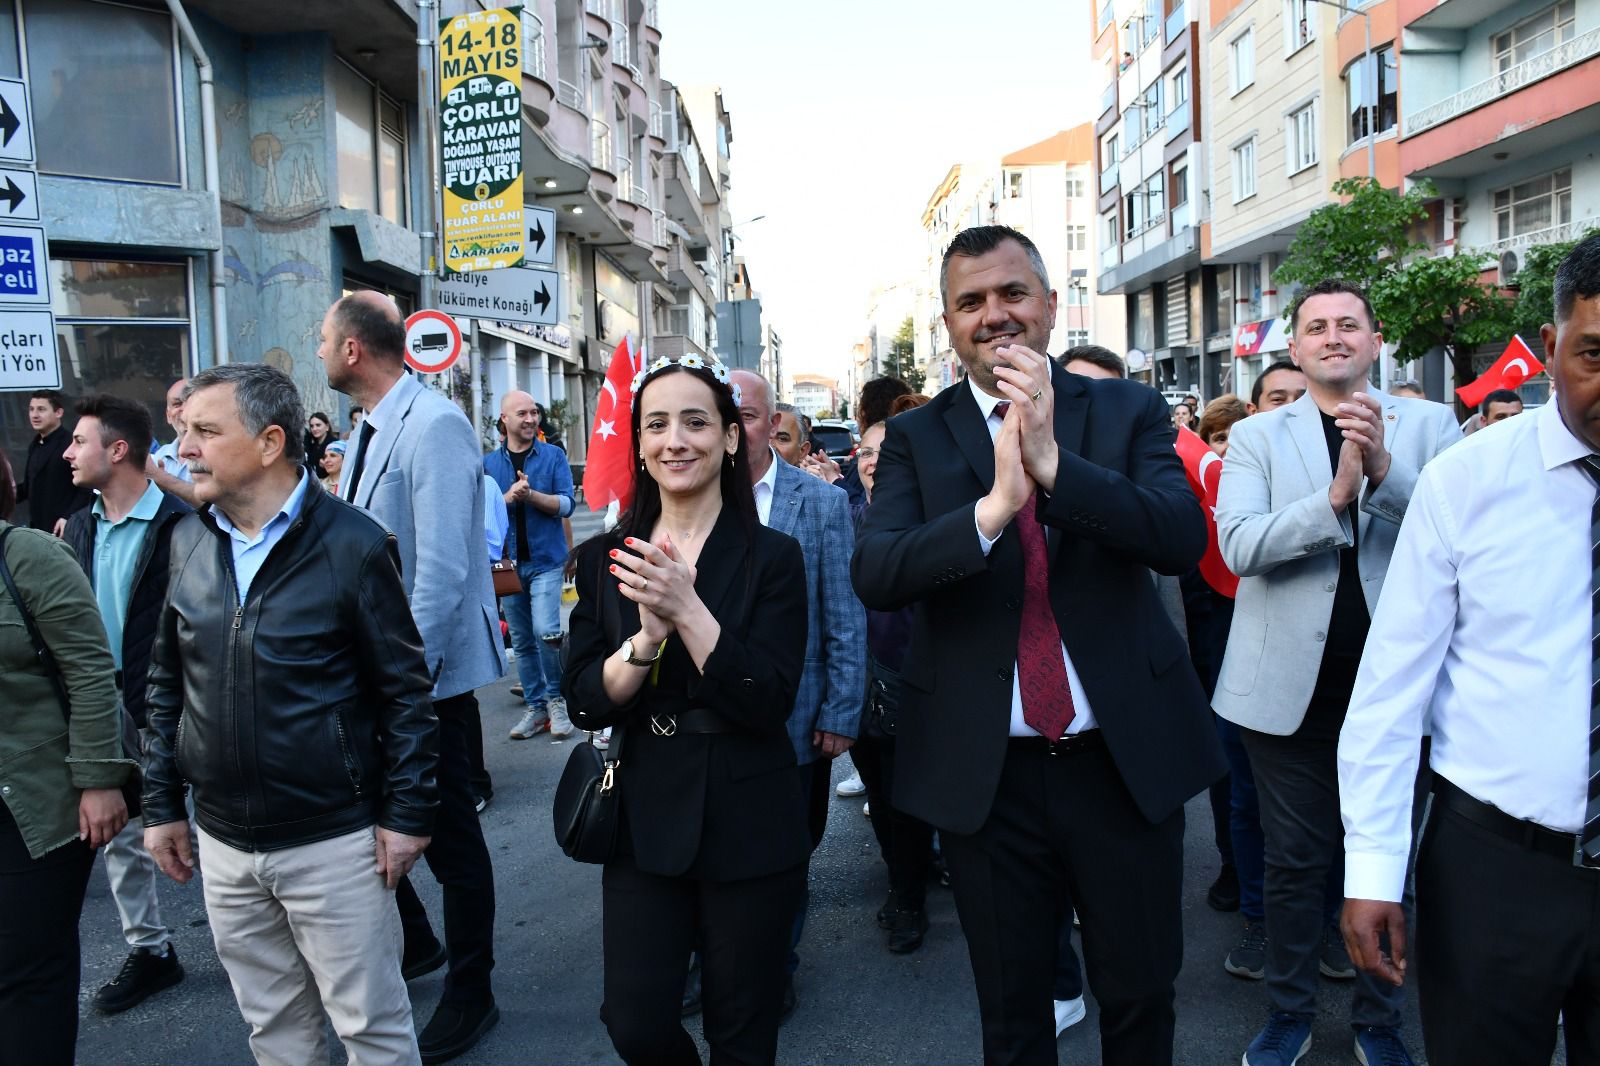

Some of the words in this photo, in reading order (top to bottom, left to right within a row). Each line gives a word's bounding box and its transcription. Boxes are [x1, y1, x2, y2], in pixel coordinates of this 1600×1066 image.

[443, 23, 516, 56] 14-18
[443, 48, 519, 79] MAYIS
[443, 98, 520, 129] ÇORLU
[443, 119, 520, 145] KARAVAN
[443, 142, 484, 159] DOĞADA
[486, 136, 520, 153] YAŞAM
[485, 150, 520, 167] OUTDOOR
[445, 163, 518, 188] FUARI
[461, 199, 504, 214] ÇORLU
[446, 215, 478, 228] FUAR
[482, 210, 520, 223] ALANI
[461, 245, 520, 258] KARAVAN
[493, 296, 532, 315] Konağı
[1, 330, 43, 350] çları
[12, 354, 46, 371] Yön
